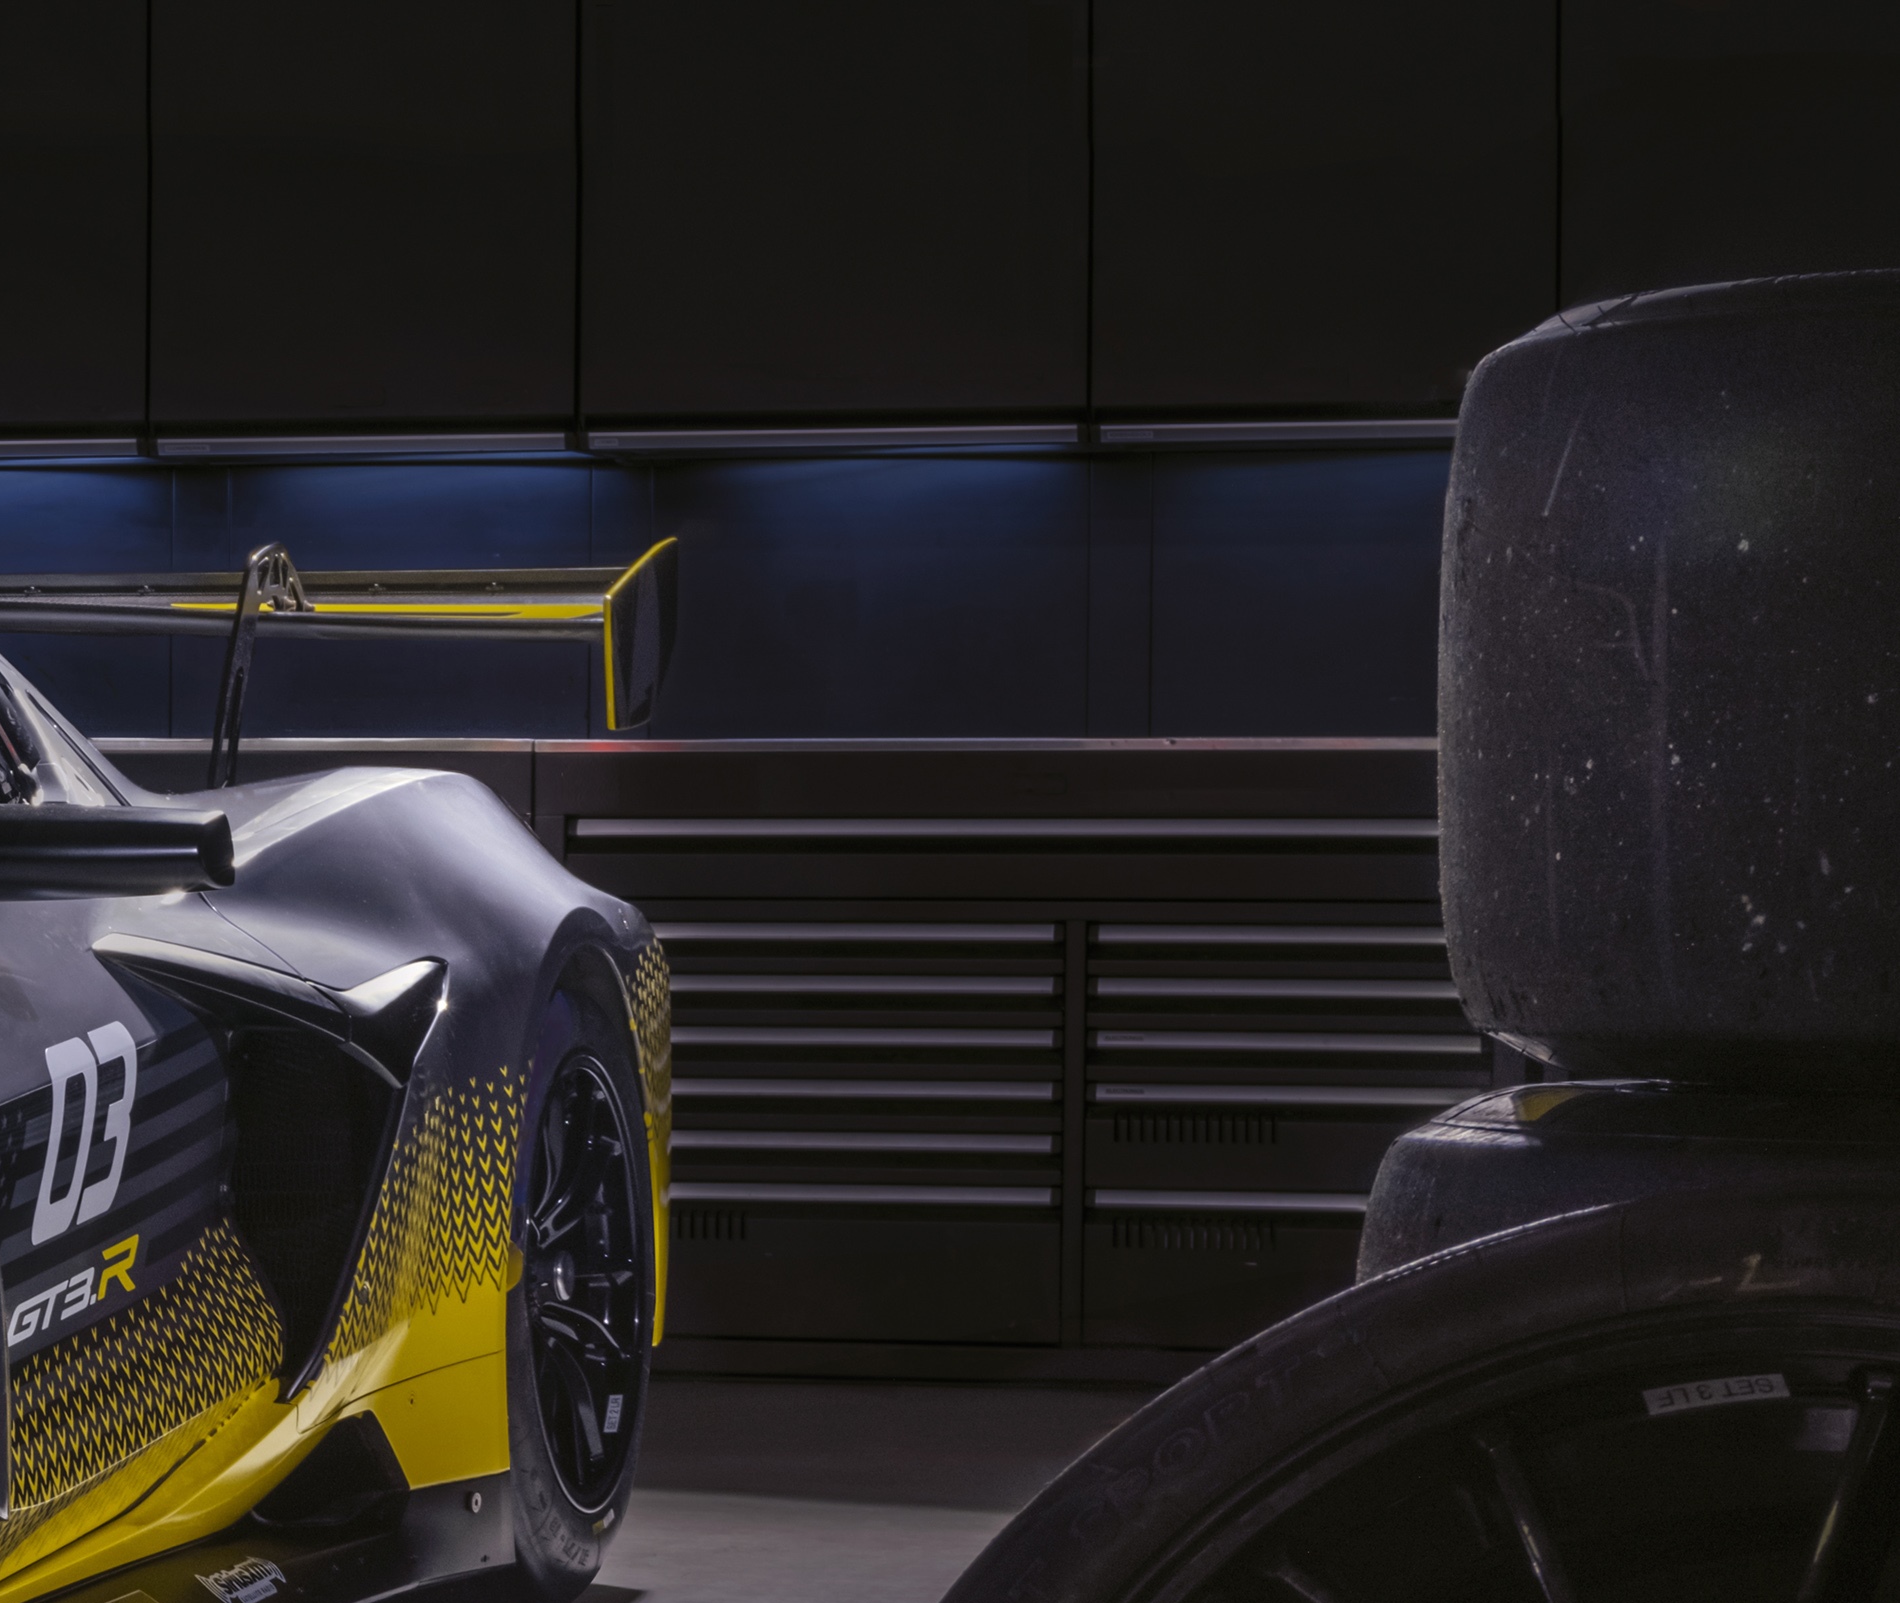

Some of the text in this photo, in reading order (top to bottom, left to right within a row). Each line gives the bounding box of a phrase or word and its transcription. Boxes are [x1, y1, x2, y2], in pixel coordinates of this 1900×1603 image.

[31, 1019, 138, 1246] 03
[1658, 1376, 1774, 1408] SET 3 LF
